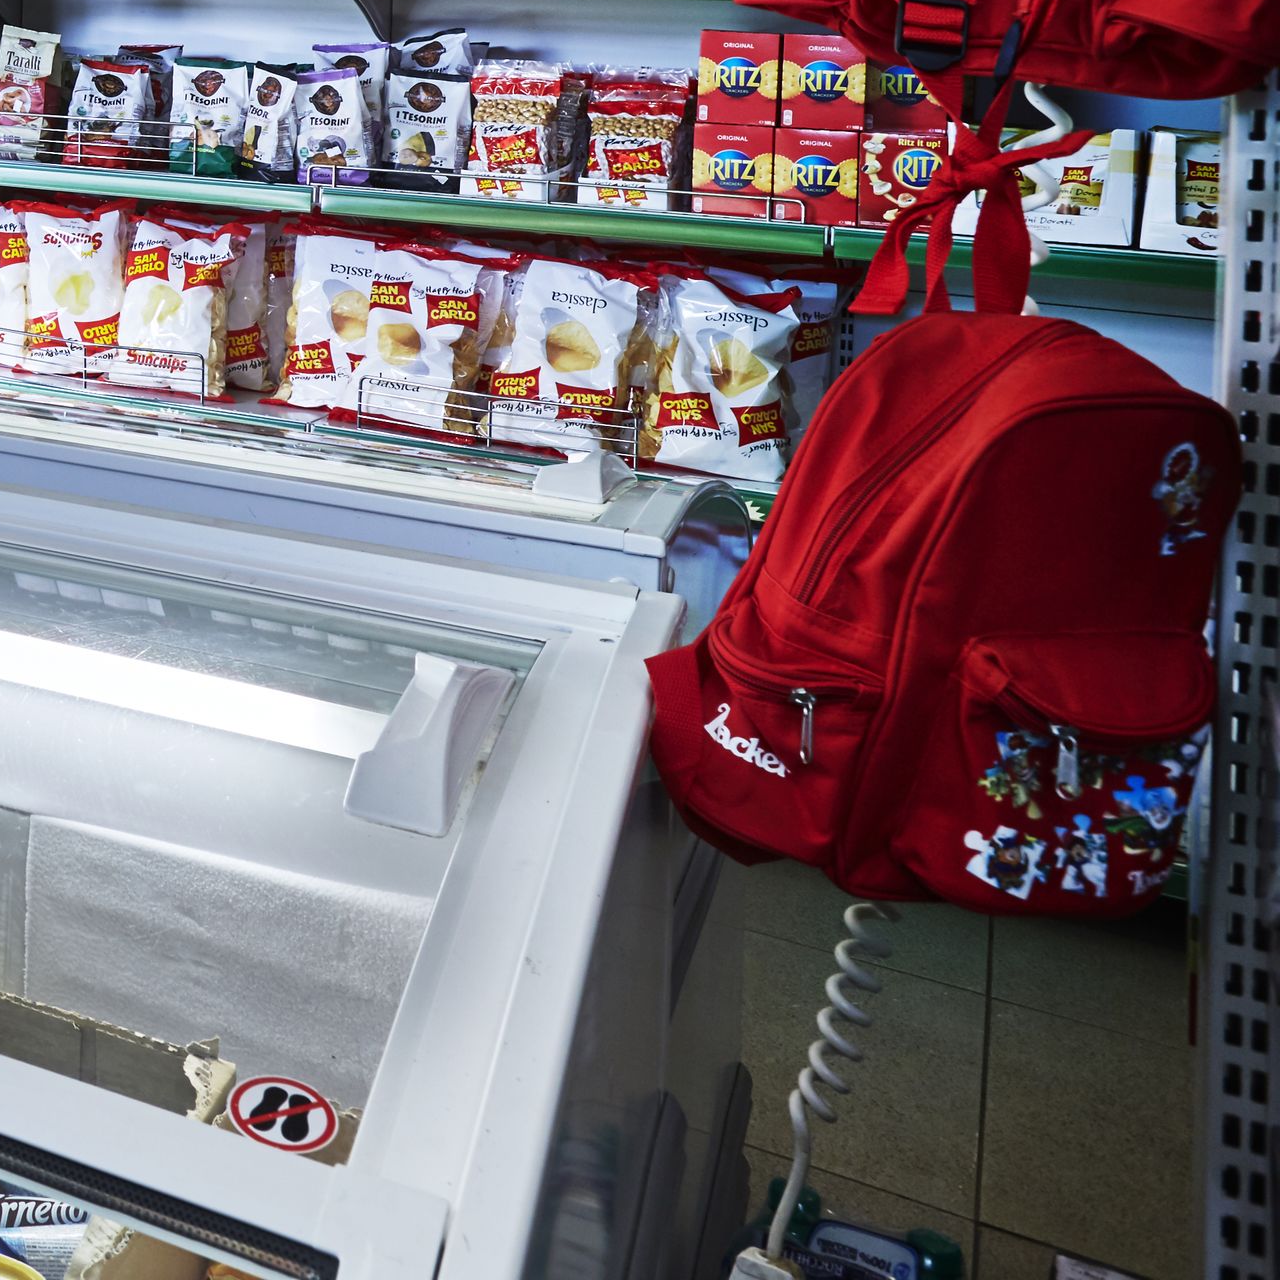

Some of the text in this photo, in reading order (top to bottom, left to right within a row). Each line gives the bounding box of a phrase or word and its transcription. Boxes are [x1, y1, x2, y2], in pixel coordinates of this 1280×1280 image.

[723, 41, 754, 50] ORIGINAL
[808, 45, 841, 53] ORIGINAL
[6, 51, 42, 70] Taralli
[714, 65, 762, 89] RITZ
[799, 69, 848, 94] RITZ
[89, 95, 125, 107] TESORINI
[191, 93, 229, 104] TESORINI
[310, 116, 349, 127] TESORINI
[404, 115, 448, 126] TESORINI
[717, 134, 748, 143] ORIGINAL
[799, 139, 833, 148] ORIGINAL
[897, 137, 942, 150] Ritz it up!
[708, 158, 756, 182] RITZ
[790, 163, 841, 187] RITZ
[134, 252, 159, 265] SAN
[128, 261, 165, 275] CARLO
[425, 285, 449, 296] Happy
[438, 300, 468, 311] SAN
[552, 291, 608, 315] classica
[430, 308, 476, 321] CARLO
[663, 398, 710, 411] CARLO
[671, 408, 703, 422] SAN
